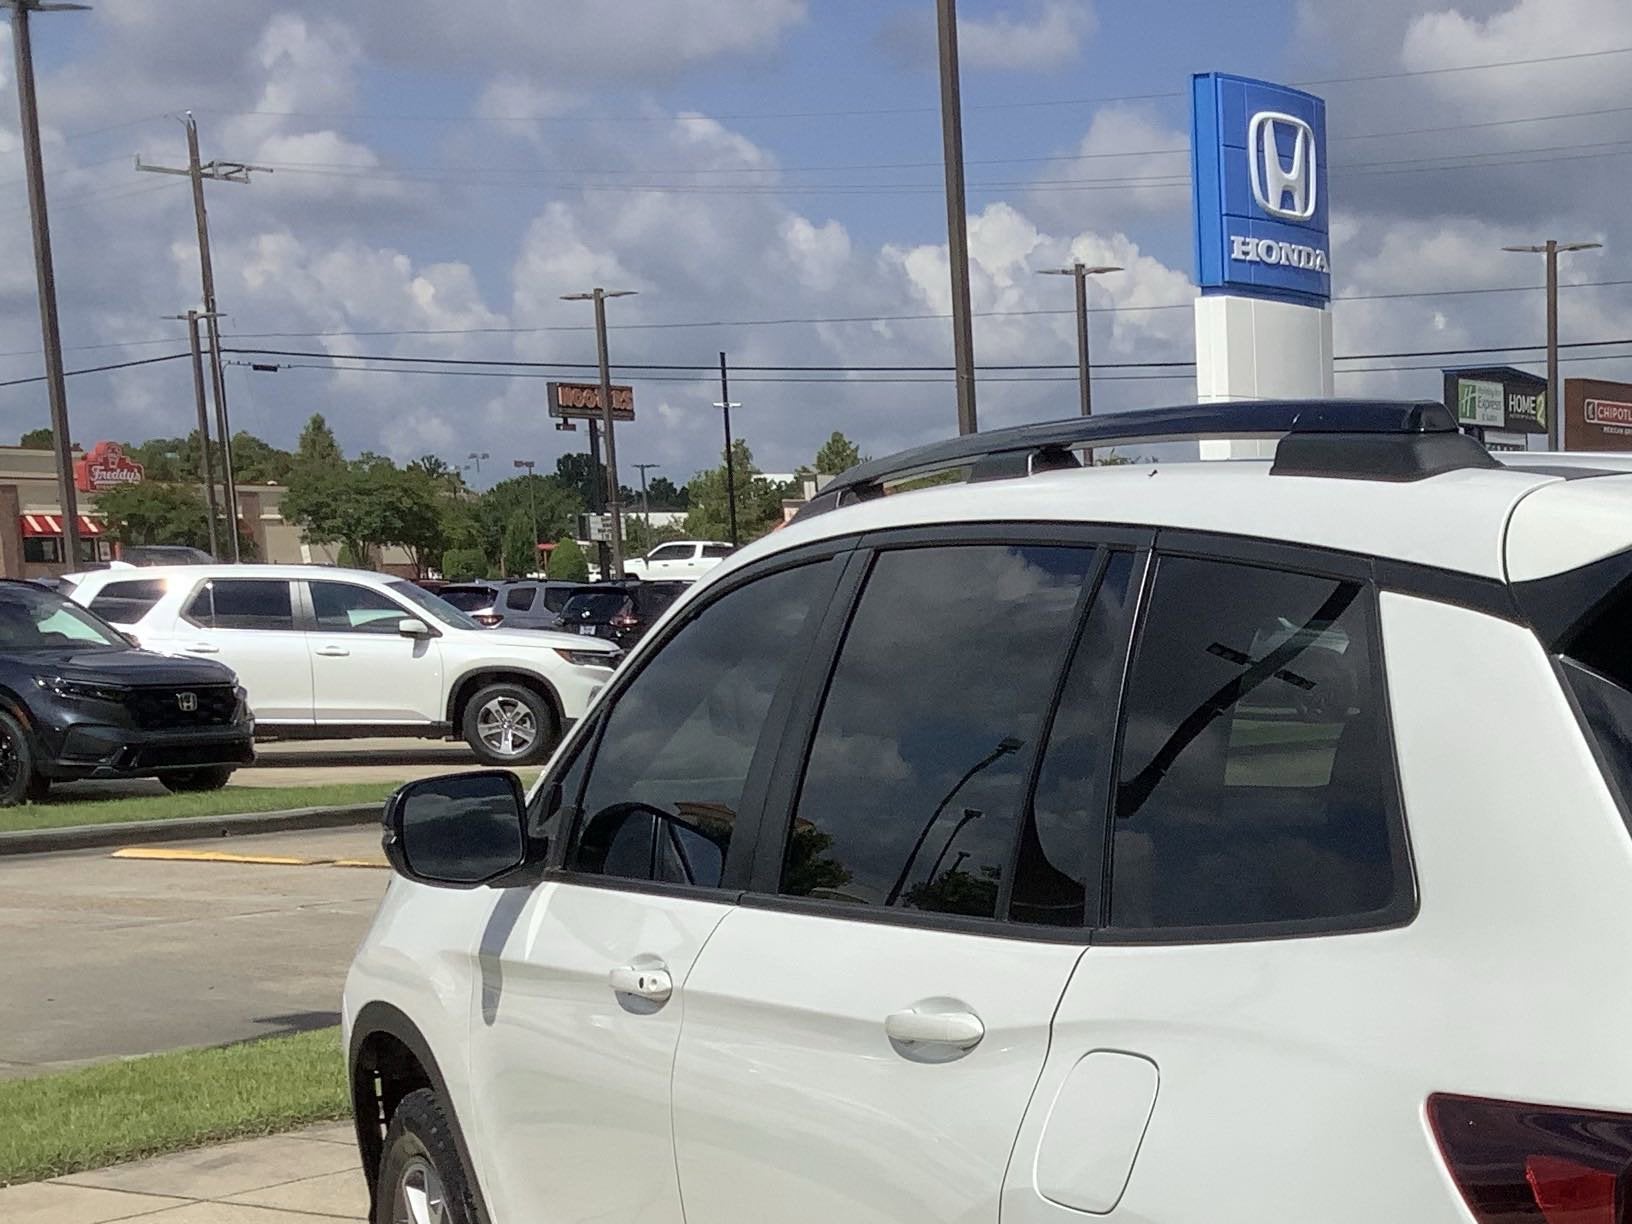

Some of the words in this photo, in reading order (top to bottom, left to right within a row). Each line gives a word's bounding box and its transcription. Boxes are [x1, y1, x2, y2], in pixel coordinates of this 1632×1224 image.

[1231, 236, 1329, 273] HONDA
[1508, 394, 1537, 414] HOME
[90, 465, 140, 483] Freddy's
